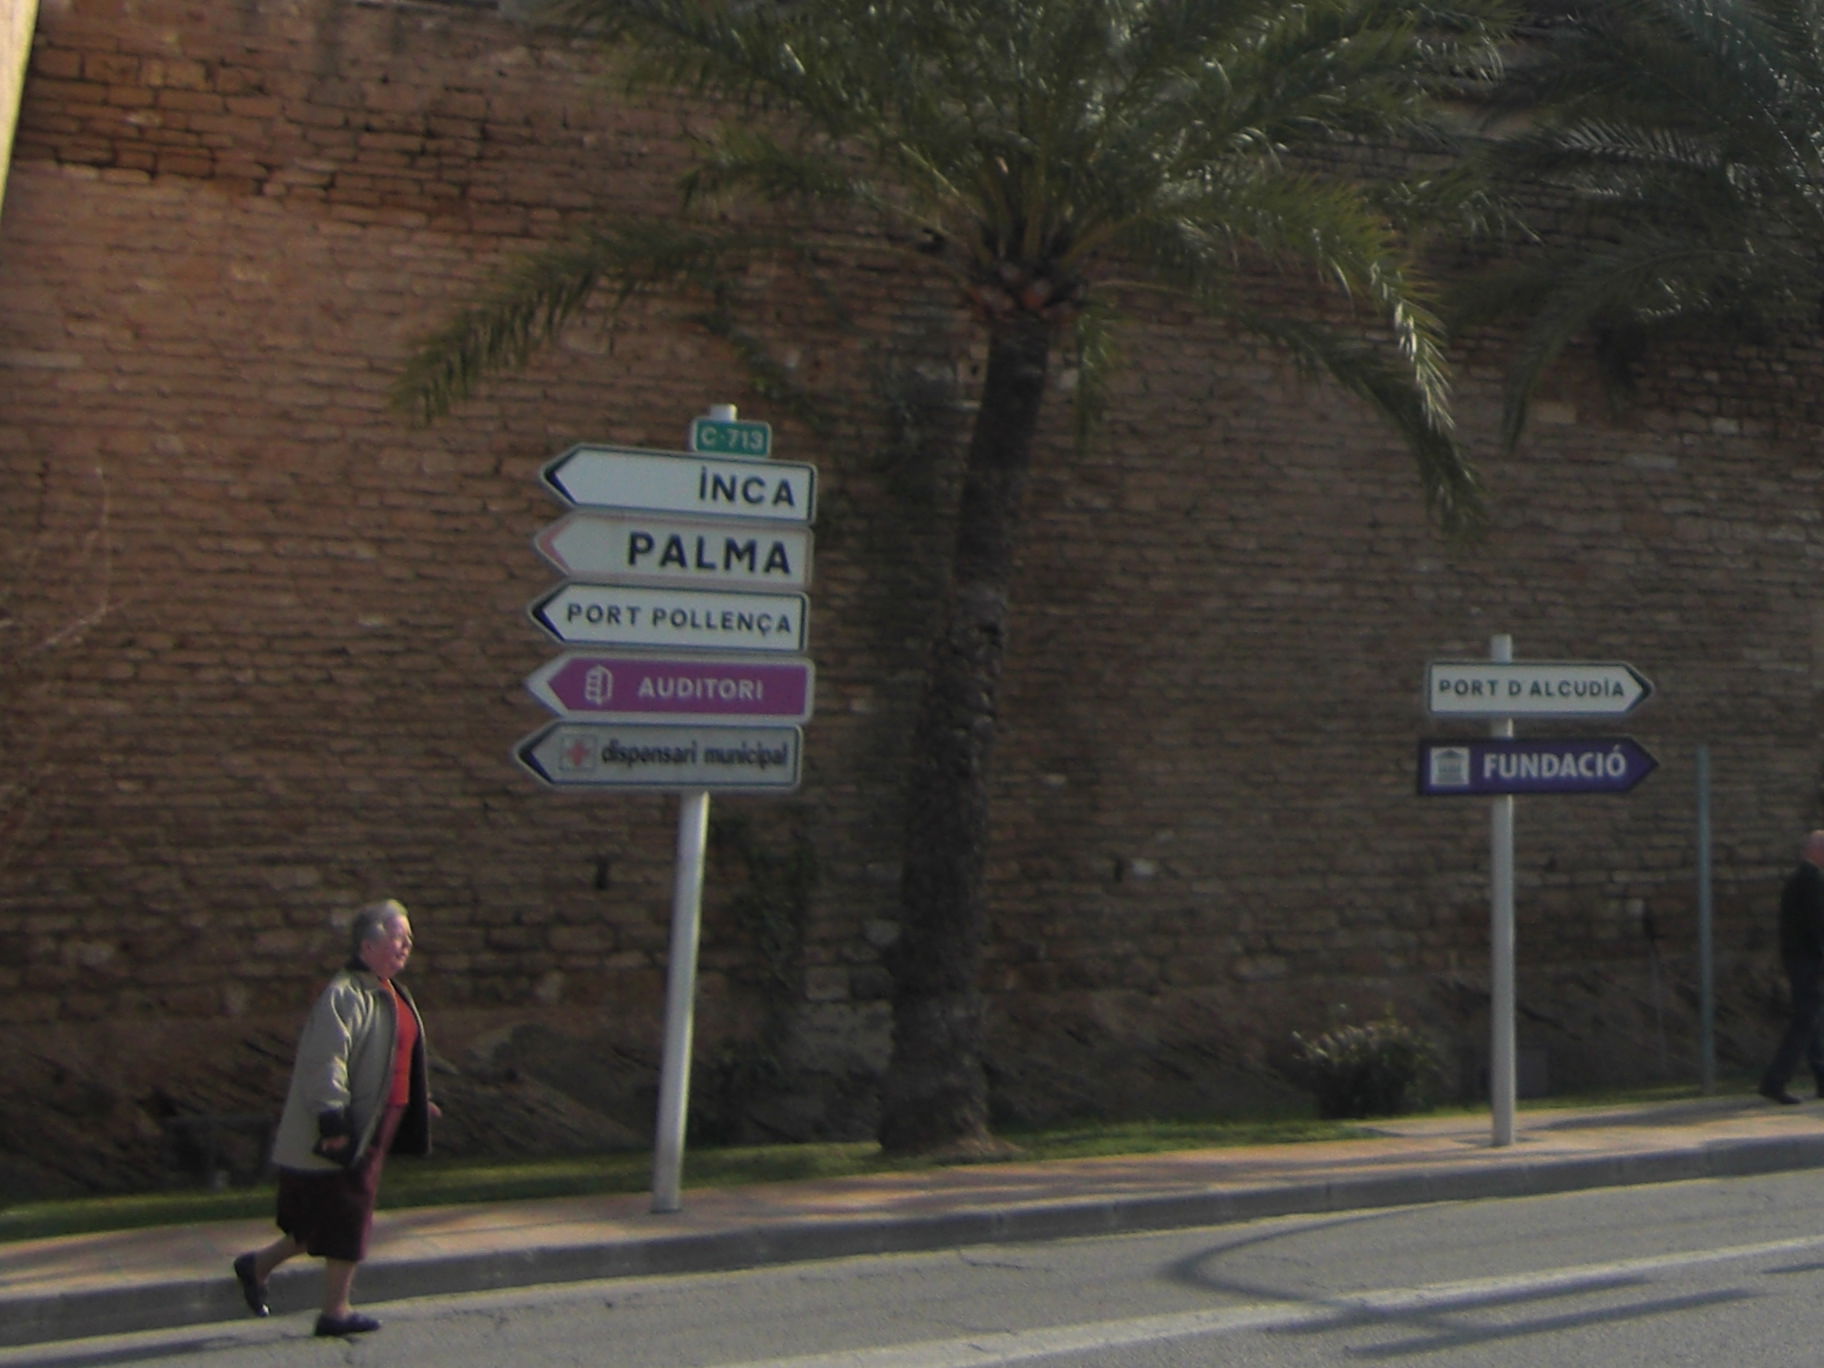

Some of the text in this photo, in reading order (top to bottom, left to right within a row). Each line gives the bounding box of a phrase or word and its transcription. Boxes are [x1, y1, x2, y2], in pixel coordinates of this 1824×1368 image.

[627, 532, 792, 574] PALMA
[567, 603, 791, 636] PORT POLLENÇA
[638, 677, 763, 700] AUDITORI
[1439, 680, 1498, 696] PORT
[602, 739, 788, 770] dispensari municipal
[1483, 745, 1627, 779] FUNDACIÓ
